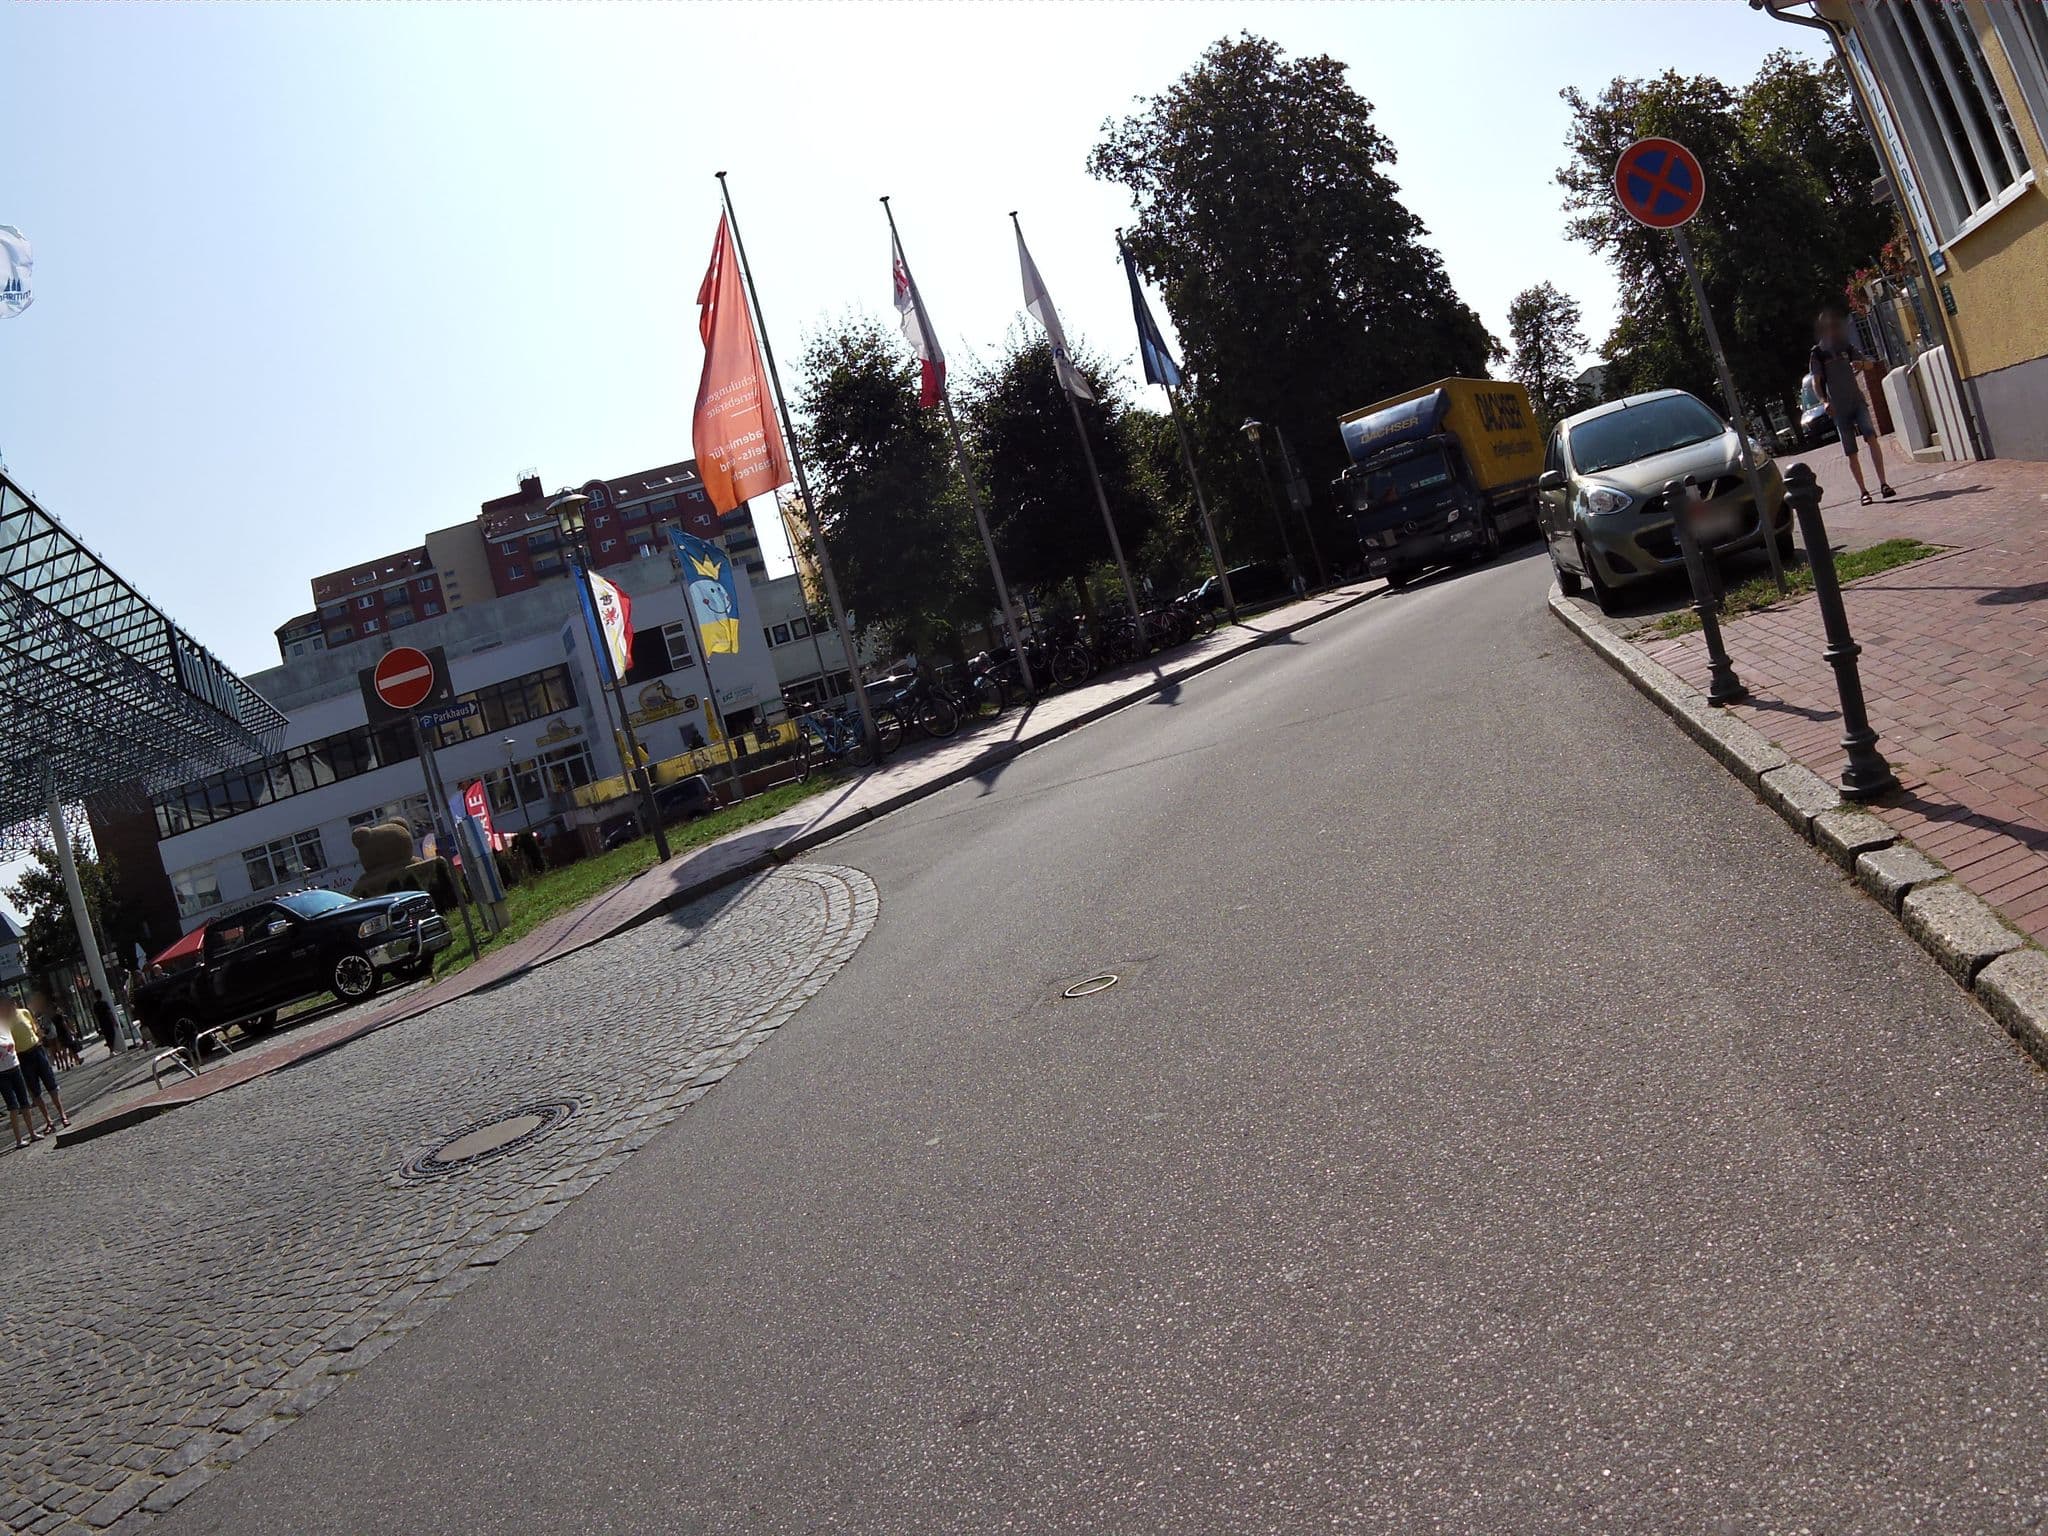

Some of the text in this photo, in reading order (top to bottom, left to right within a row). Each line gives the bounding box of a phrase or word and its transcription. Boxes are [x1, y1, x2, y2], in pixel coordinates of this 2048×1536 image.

[1848, 37, 1935, 247] PIZZERIA
[1359, 415, 1420, 445] DACHSER
[433, 706, 469, 724] Parkhaus
